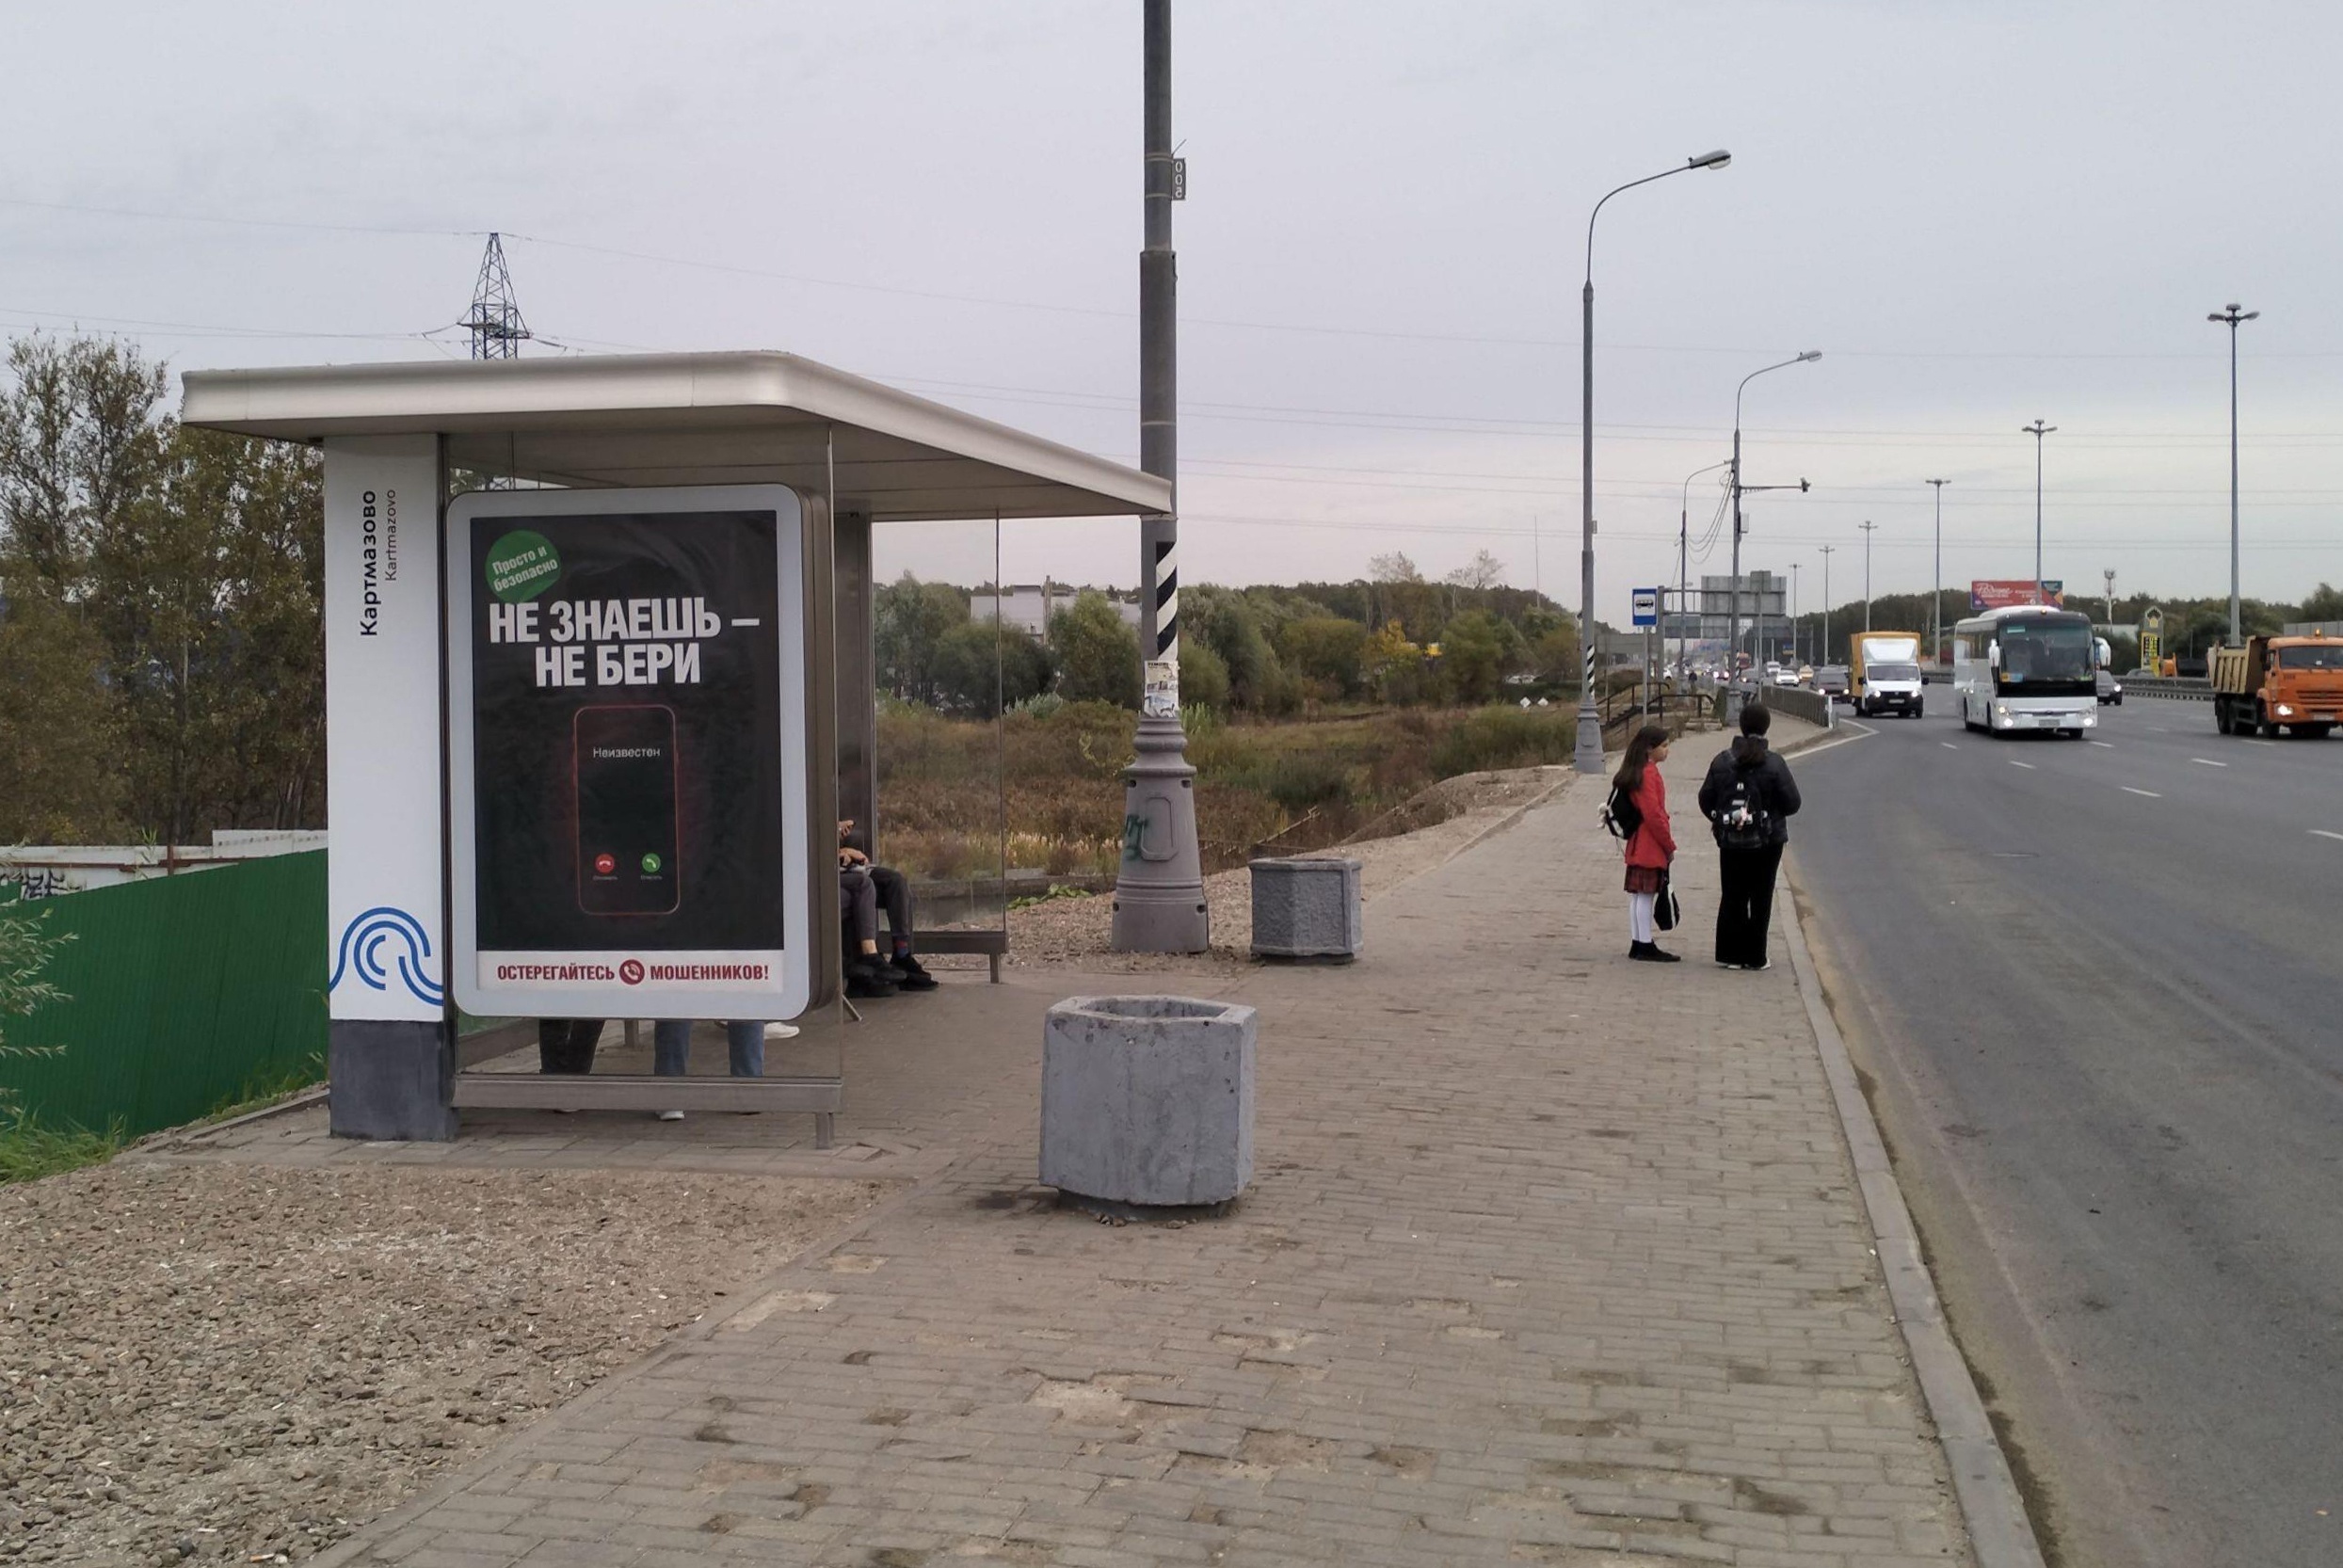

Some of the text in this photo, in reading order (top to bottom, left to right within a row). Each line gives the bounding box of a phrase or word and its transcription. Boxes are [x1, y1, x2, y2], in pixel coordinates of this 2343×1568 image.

[385, 489, 396, 582] Kartmazovo
[360, 490, 381, 636] Картмазово
[492, 546, 547, 575] Просто и
[493, 559, 558, 592] безопасно
[489, 602, 539, 643] НЕ
[550, 597, 721, 642] ЗНАЕШЬ
[536, 642, 700, 687] НЕ БЕРИ
[593, 747, 661, 759] Неизвестен
[497, 963, 769, 981] ОСТЕРЕГАЙТЕСЬ МОШЕННИКОВ!
